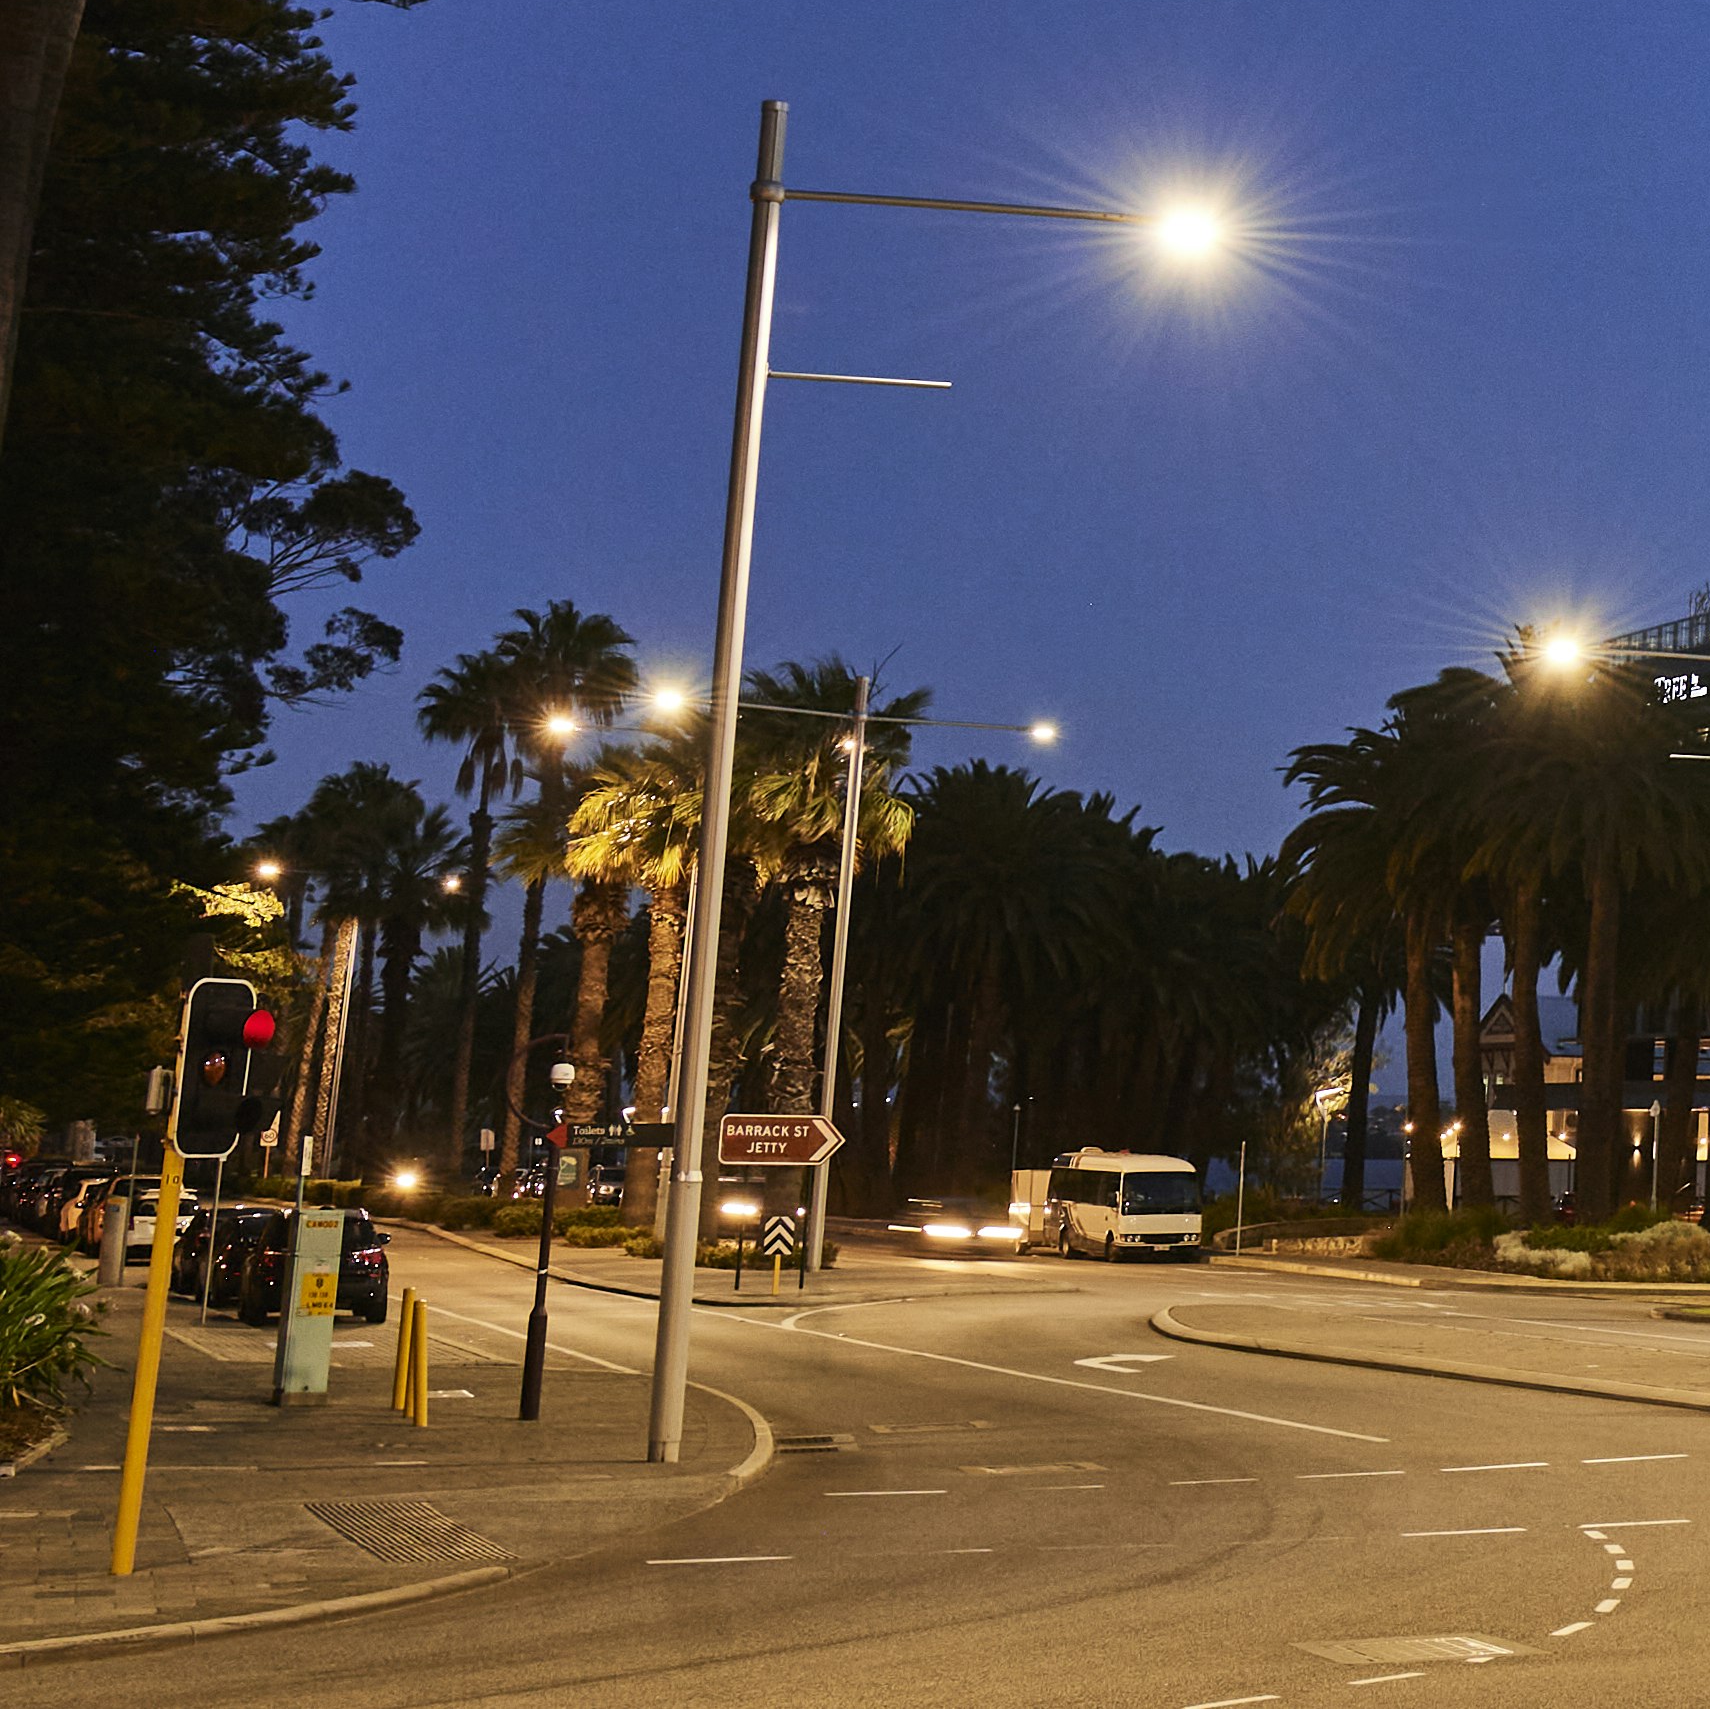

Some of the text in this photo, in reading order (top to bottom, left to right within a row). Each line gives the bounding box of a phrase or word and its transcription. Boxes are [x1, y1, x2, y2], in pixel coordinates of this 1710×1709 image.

[573, 1125, 606, 1136] Toilets
[726, 1124, 809, 1138] BARRACK ST
[746, 1141, 787, 1154] JETTY
